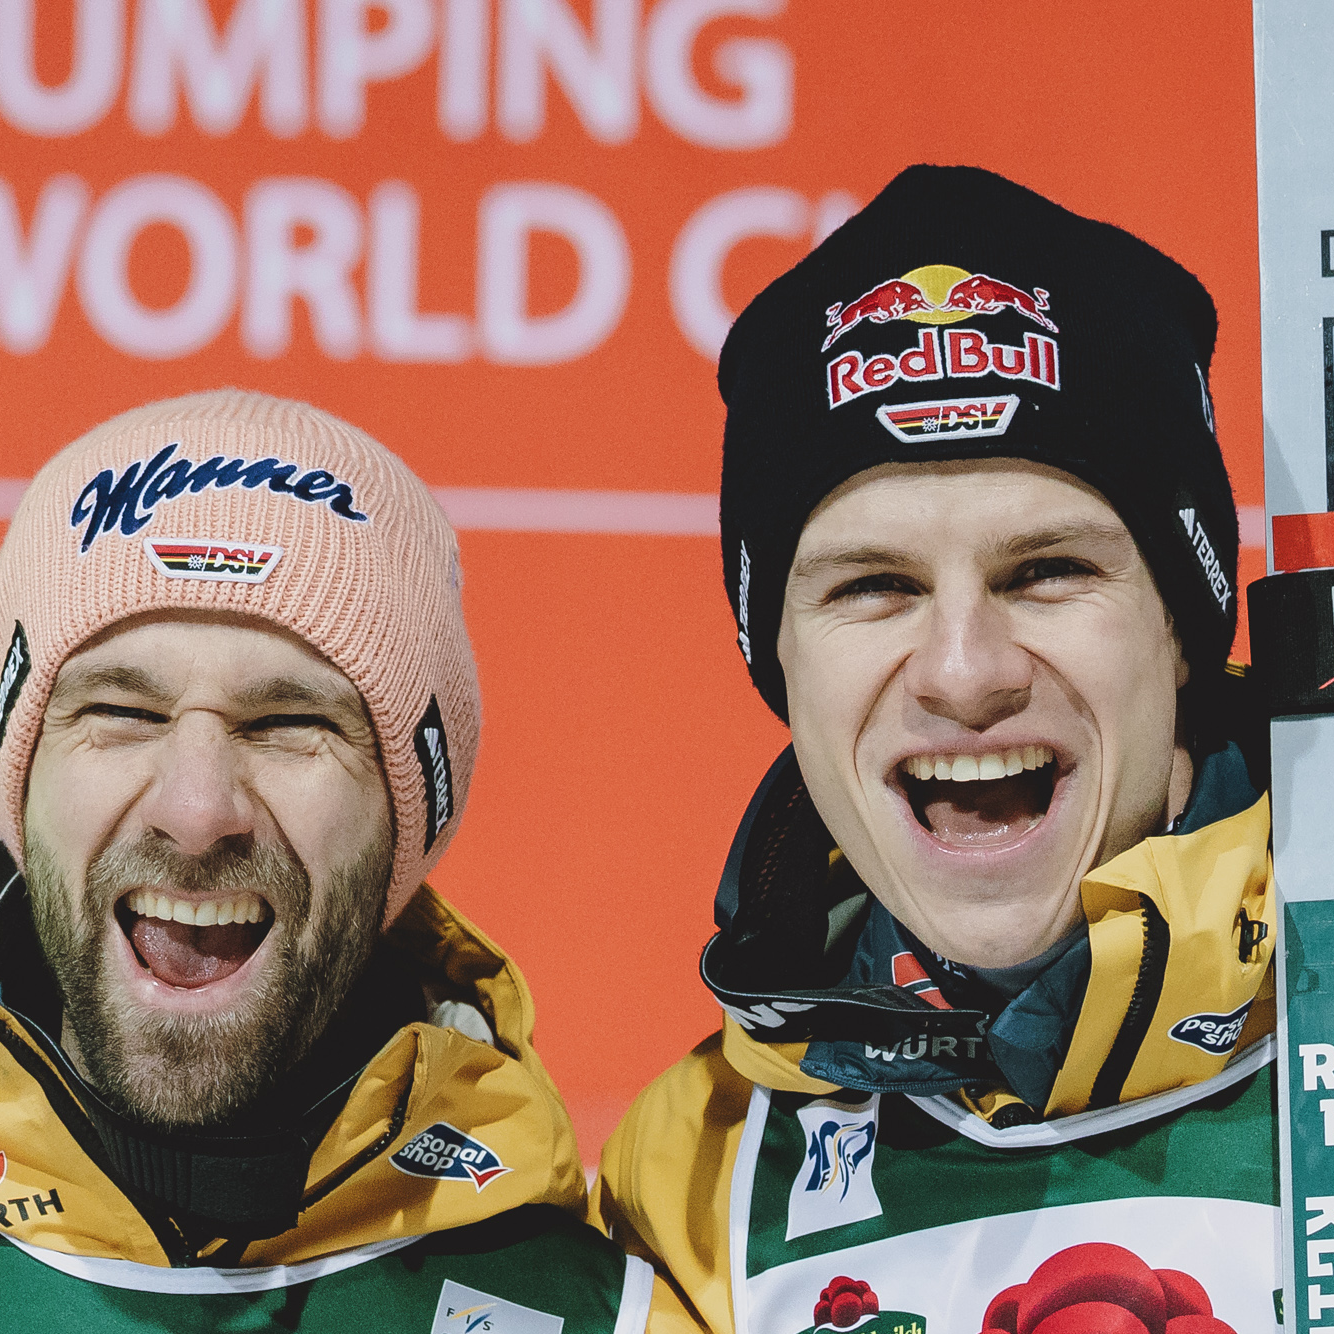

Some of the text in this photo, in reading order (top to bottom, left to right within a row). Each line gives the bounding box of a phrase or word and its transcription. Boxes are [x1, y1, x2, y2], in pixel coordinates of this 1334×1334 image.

[827, 327, 1060, 409] Red Bull
[939, 404, 1006, 432] DSV
[71, 442, 369, 554] Manner
[207, 546, 270, 576] DSV
[1193, 521, 1232, 614] TERREX
[1180, 1012, 1248, 1034] perso
[1201, 1026, 1243, 1046] sho
[864, 1034, 993, 1062] WÜRT
[399, 1143, 454, 1171] shop
[409, 1132, 487, 1164] rsonal
